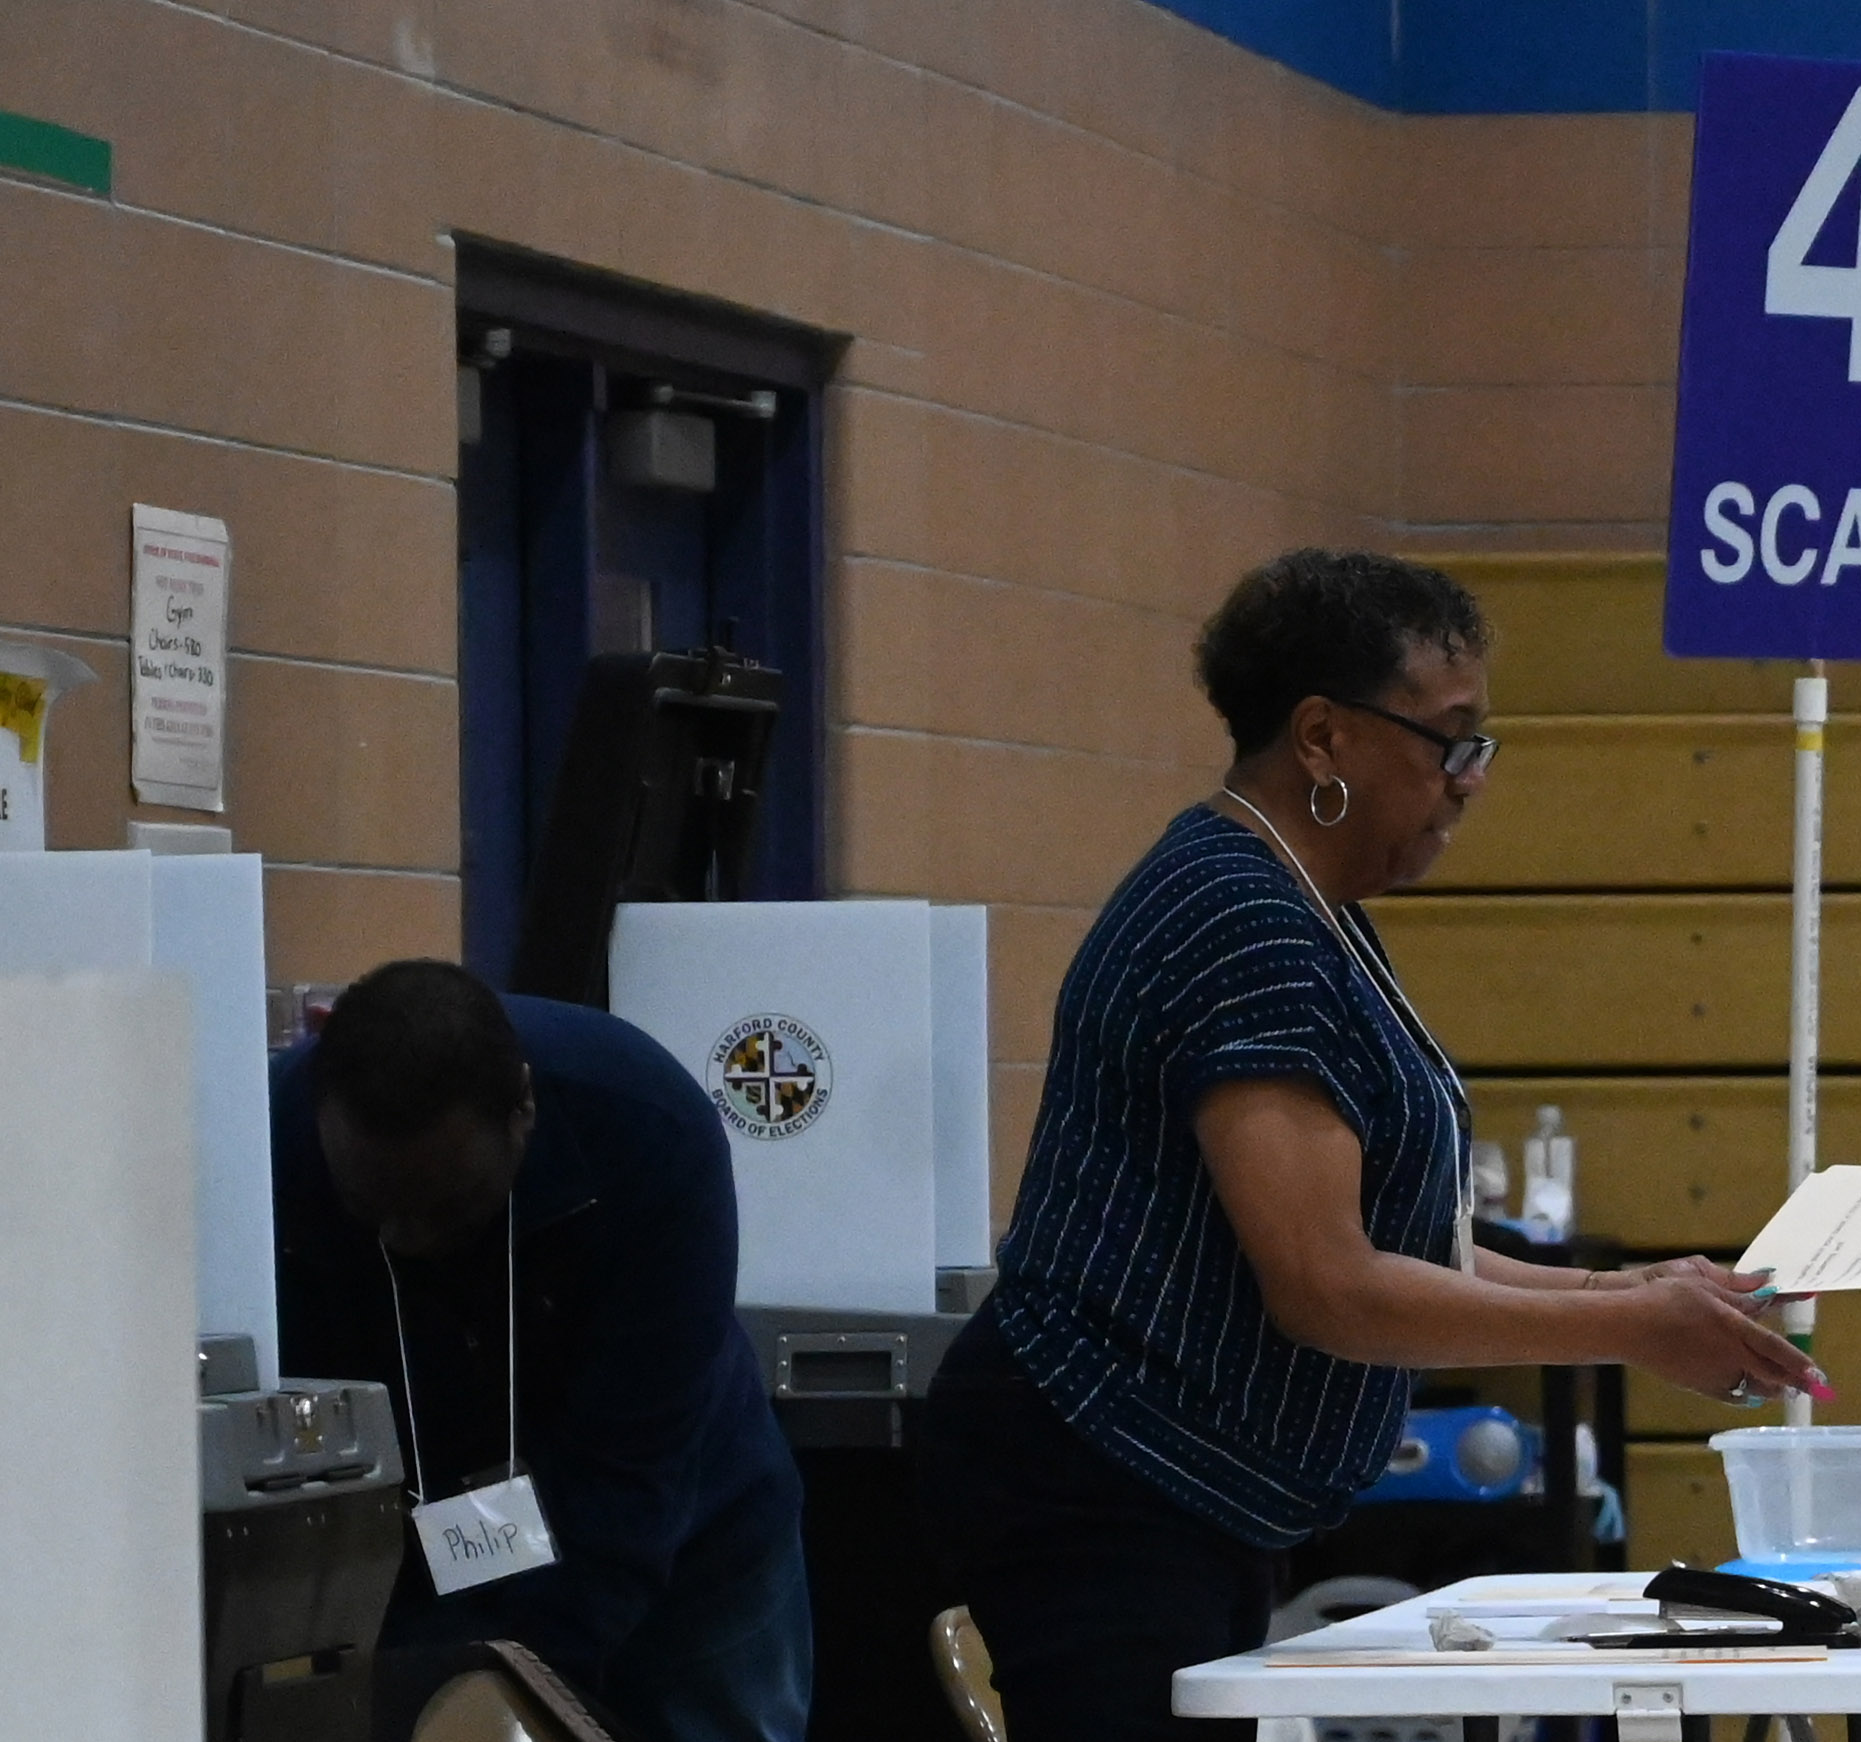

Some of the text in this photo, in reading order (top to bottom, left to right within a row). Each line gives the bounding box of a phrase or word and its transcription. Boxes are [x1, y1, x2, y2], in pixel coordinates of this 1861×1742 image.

[166, 594, 193, 629] Gym
[713, 1018, 825, 1063] HARFORD COUNTY
[711, 1088, 828, 1137] BOARD OF ELECTIONS
